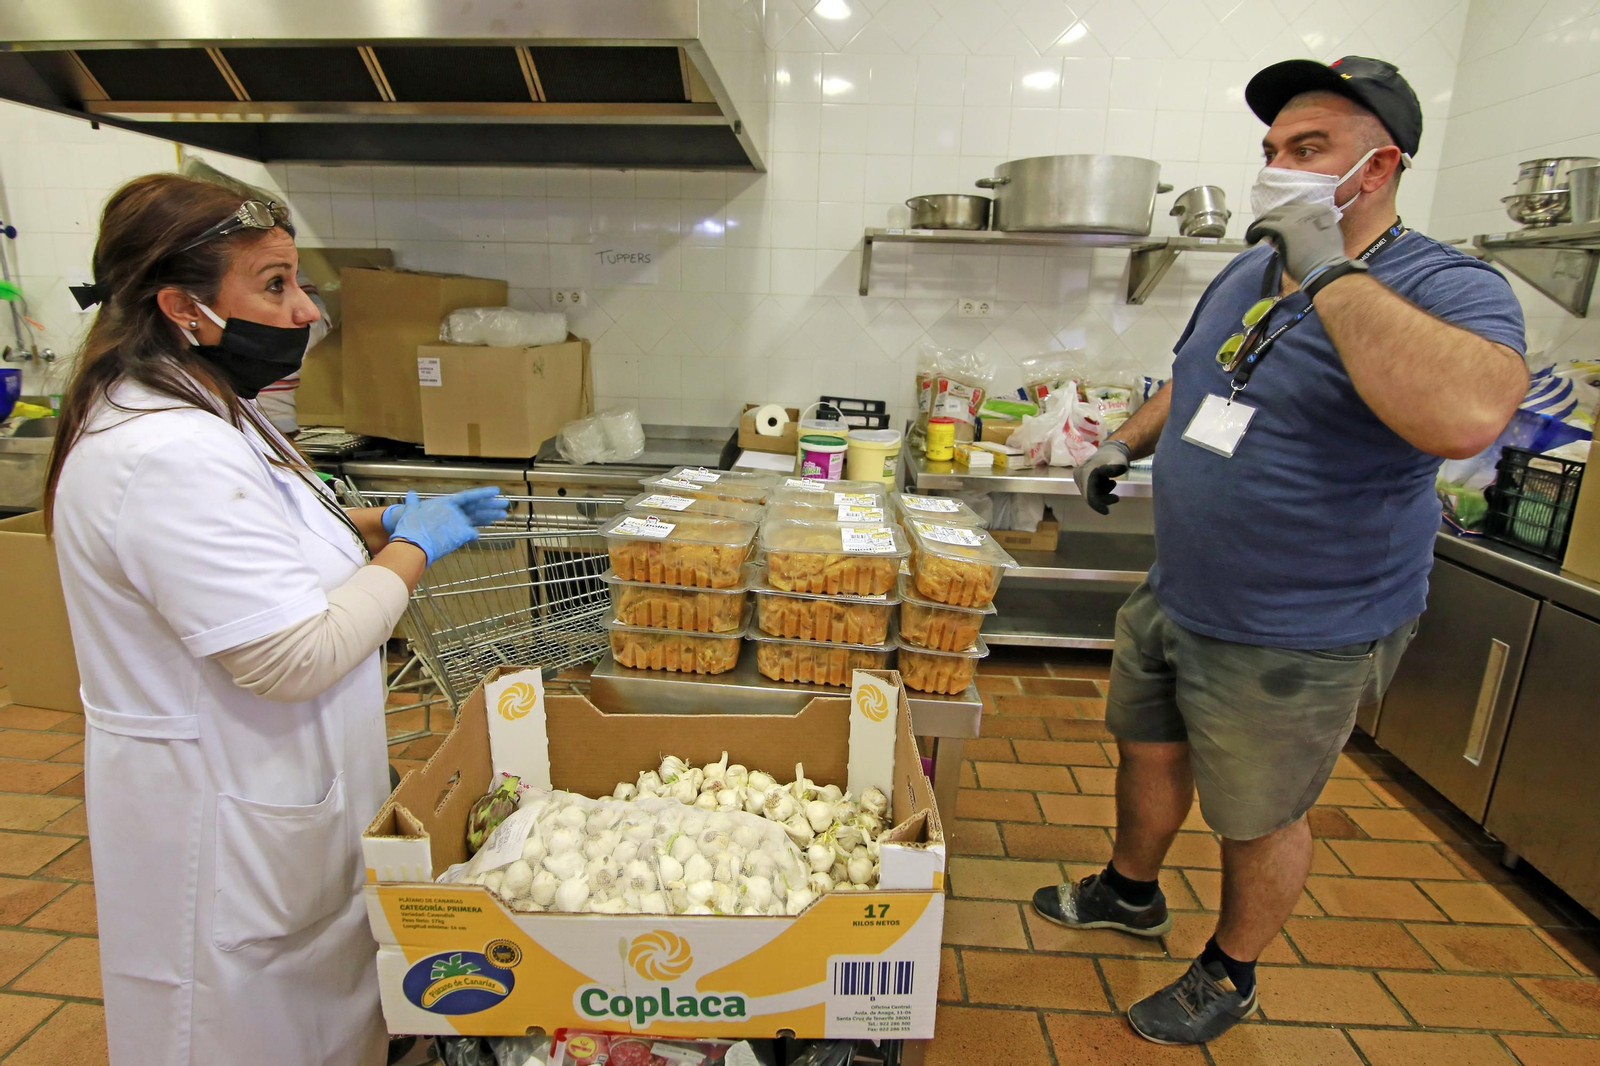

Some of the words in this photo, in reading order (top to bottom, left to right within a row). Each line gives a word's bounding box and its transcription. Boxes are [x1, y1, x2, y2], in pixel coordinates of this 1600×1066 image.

[594, 249, 651, 265] TUPPERS
[400, 904, 445, 912] CATEGORÍA:
[447, 905, 483, 913] PRIMERA
[864, 904, 890, 918] 17
[463, 978, 496, 988] Canarias
[580, 987, 746, 1024] Coplaca
